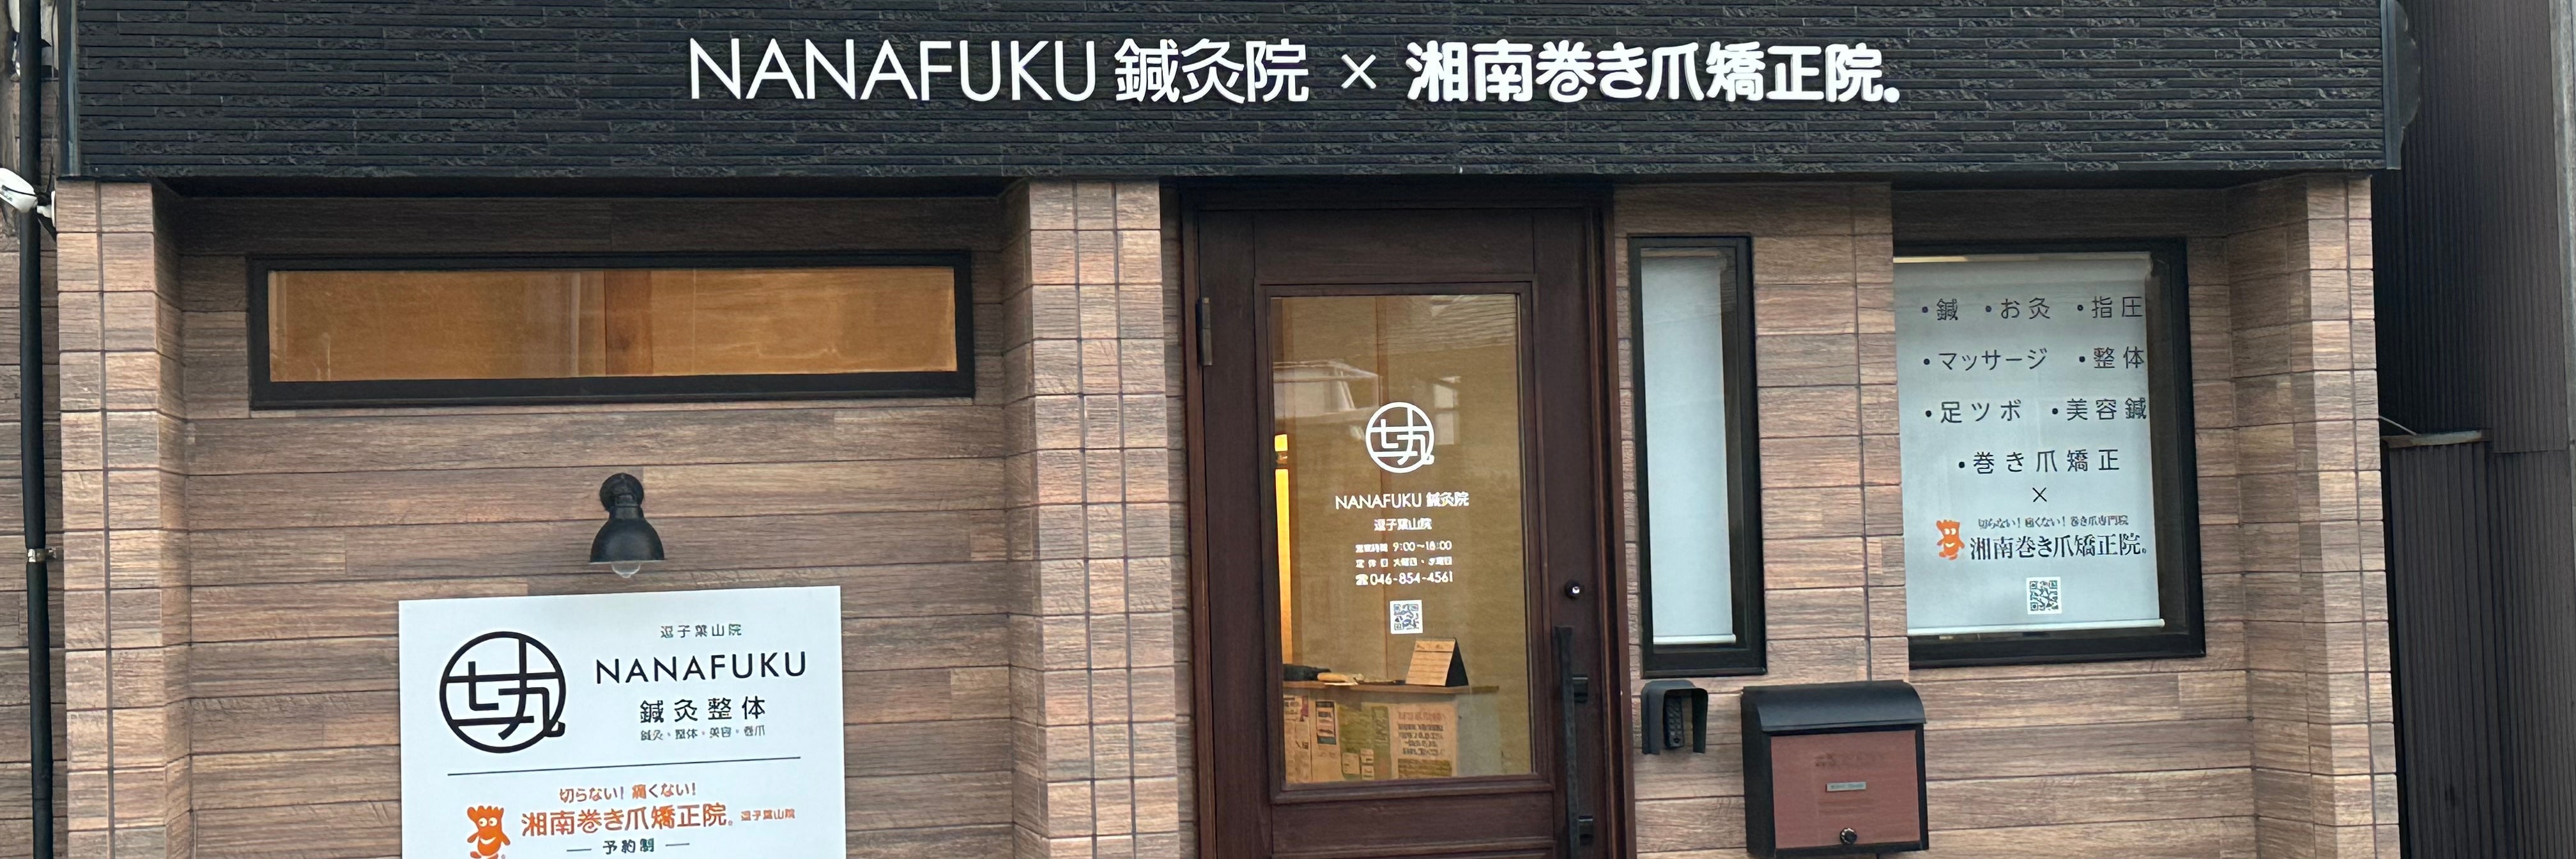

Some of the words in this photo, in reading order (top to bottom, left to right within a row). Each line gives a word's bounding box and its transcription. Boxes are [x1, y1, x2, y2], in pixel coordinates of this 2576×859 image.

[690, 37, 1096, 102] NANAFUKU
[1115, 38, 1309, 104] 鍼灸院
[1335, 493, 1422, 510] NANAFUKU
[595, 651, 806, 685] NANAFUKU
[640, 695, 765, 724] 鍼灸整体
